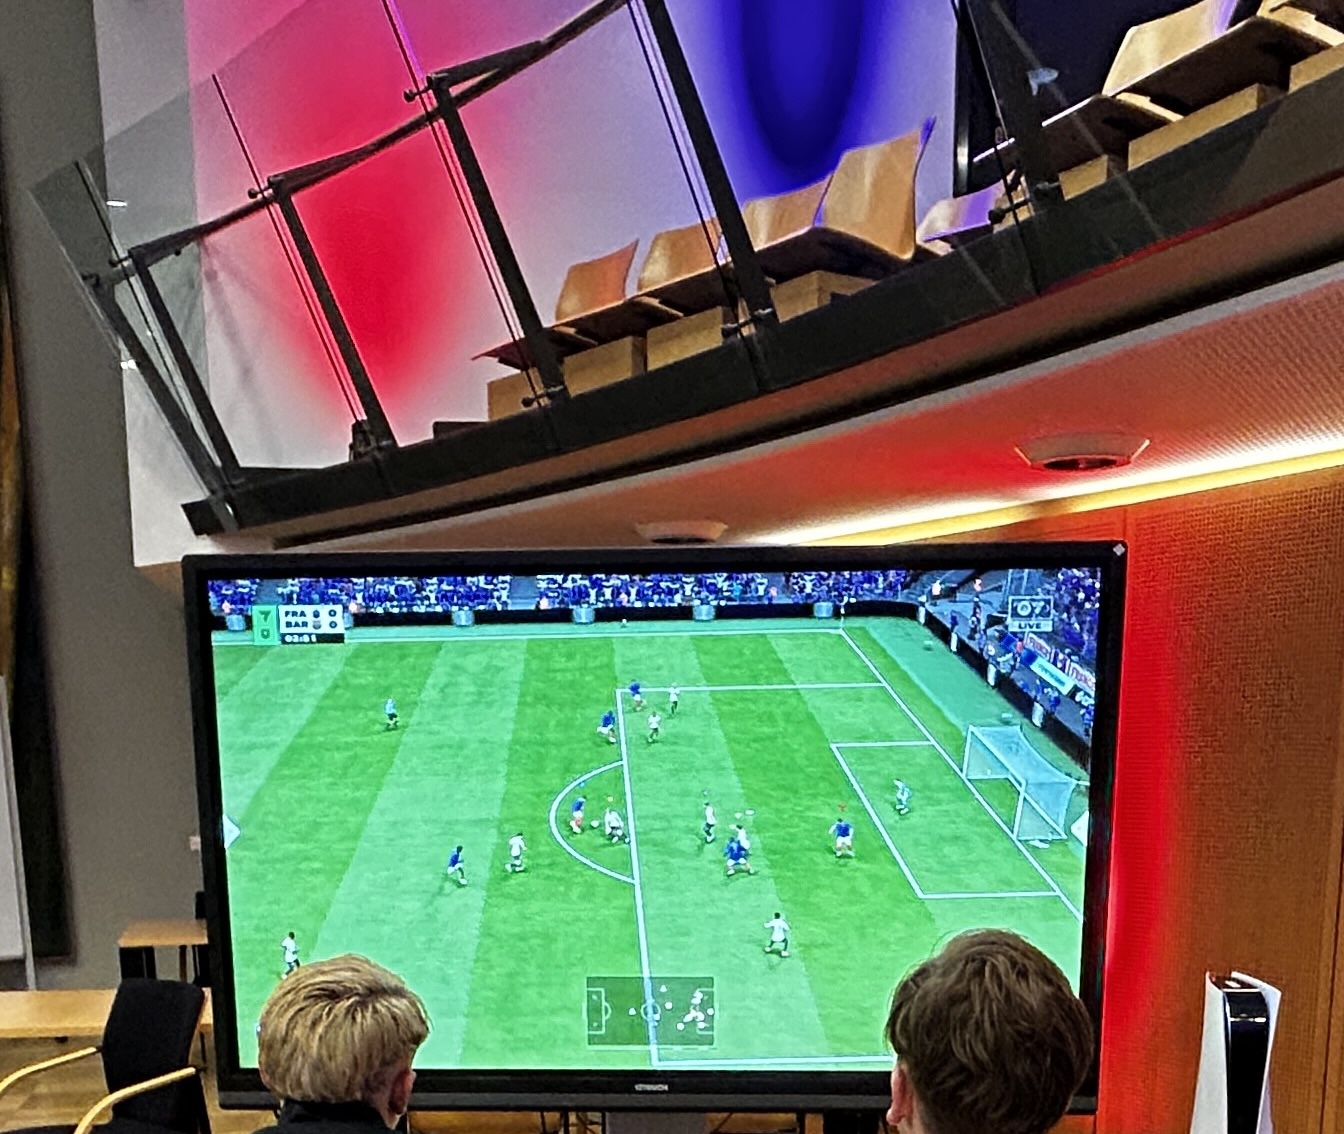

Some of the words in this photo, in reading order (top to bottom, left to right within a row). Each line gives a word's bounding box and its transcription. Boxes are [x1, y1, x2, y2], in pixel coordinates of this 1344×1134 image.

[284, 610, 307, 618] FRA
[328, 609, 337, 617] 0
[285, 620, 308, 629] BAR
[329, 620, 338, 629] 0
[1018, 622, 1042, 630] LIVE
